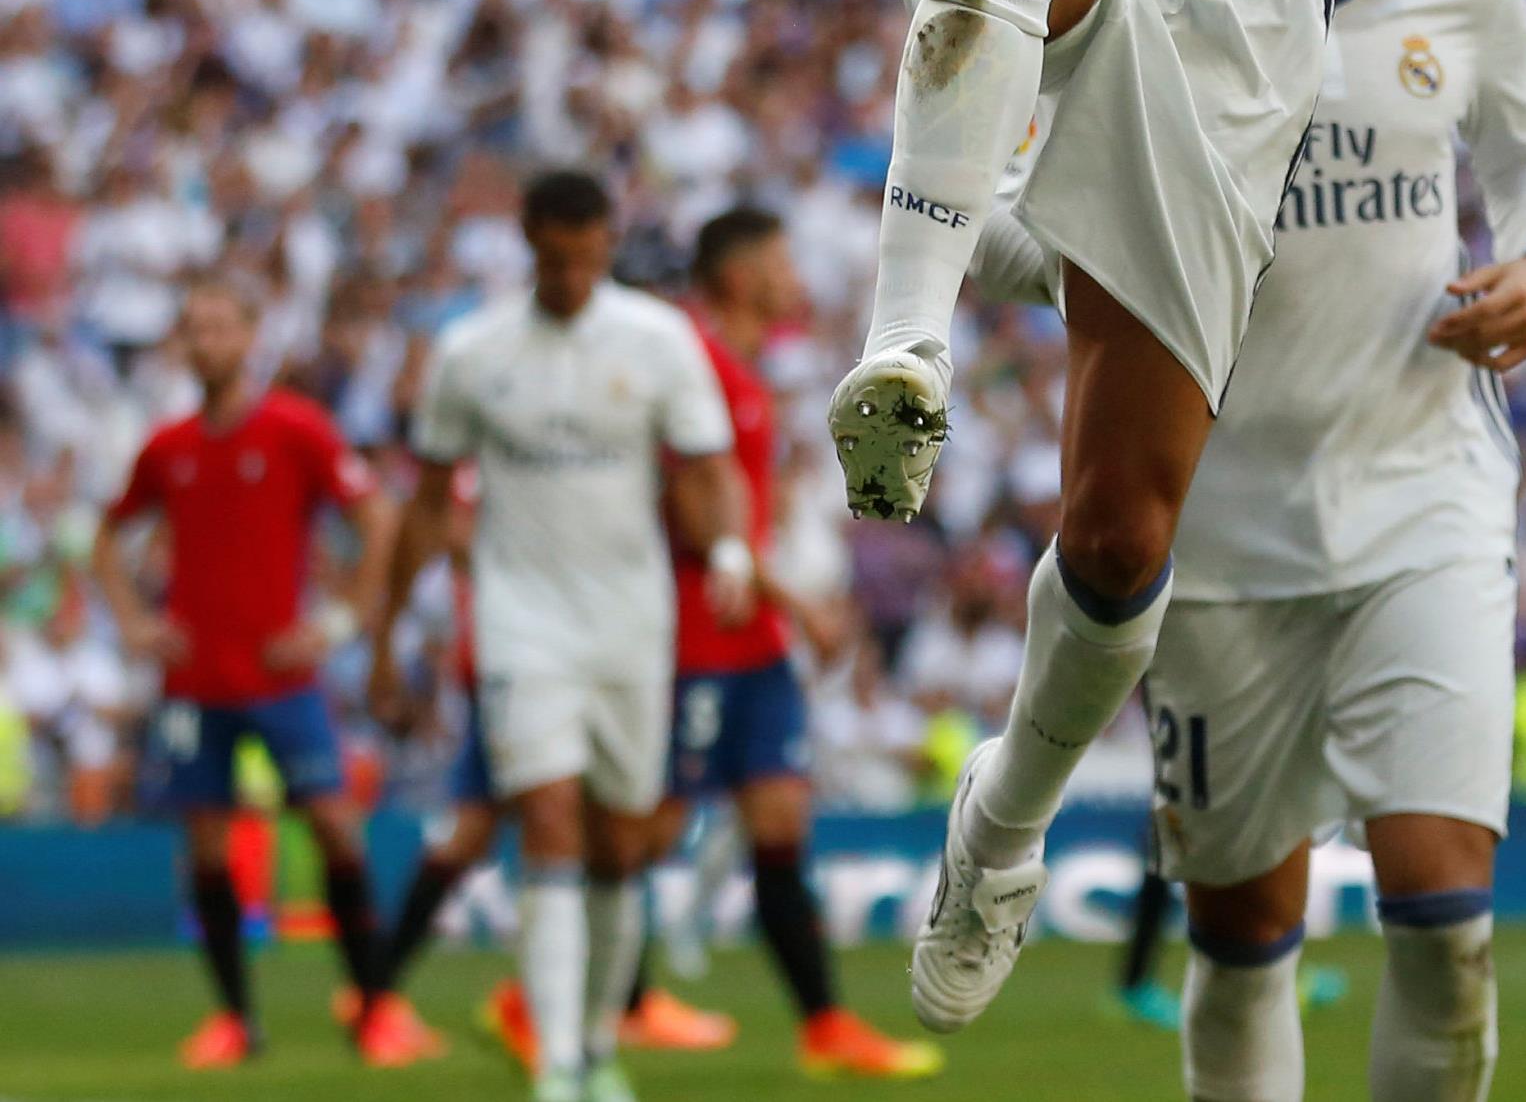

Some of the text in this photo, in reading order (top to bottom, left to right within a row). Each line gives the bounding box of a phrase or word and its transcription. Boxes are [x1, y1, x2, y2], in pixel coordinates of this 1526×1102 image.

[1302, 122, 1376, 166] Fly
[890, 186, 970, 229] RMCF
[1154, 703, 1208, 810] 21
[993, 883, 1037, 906] umbro
